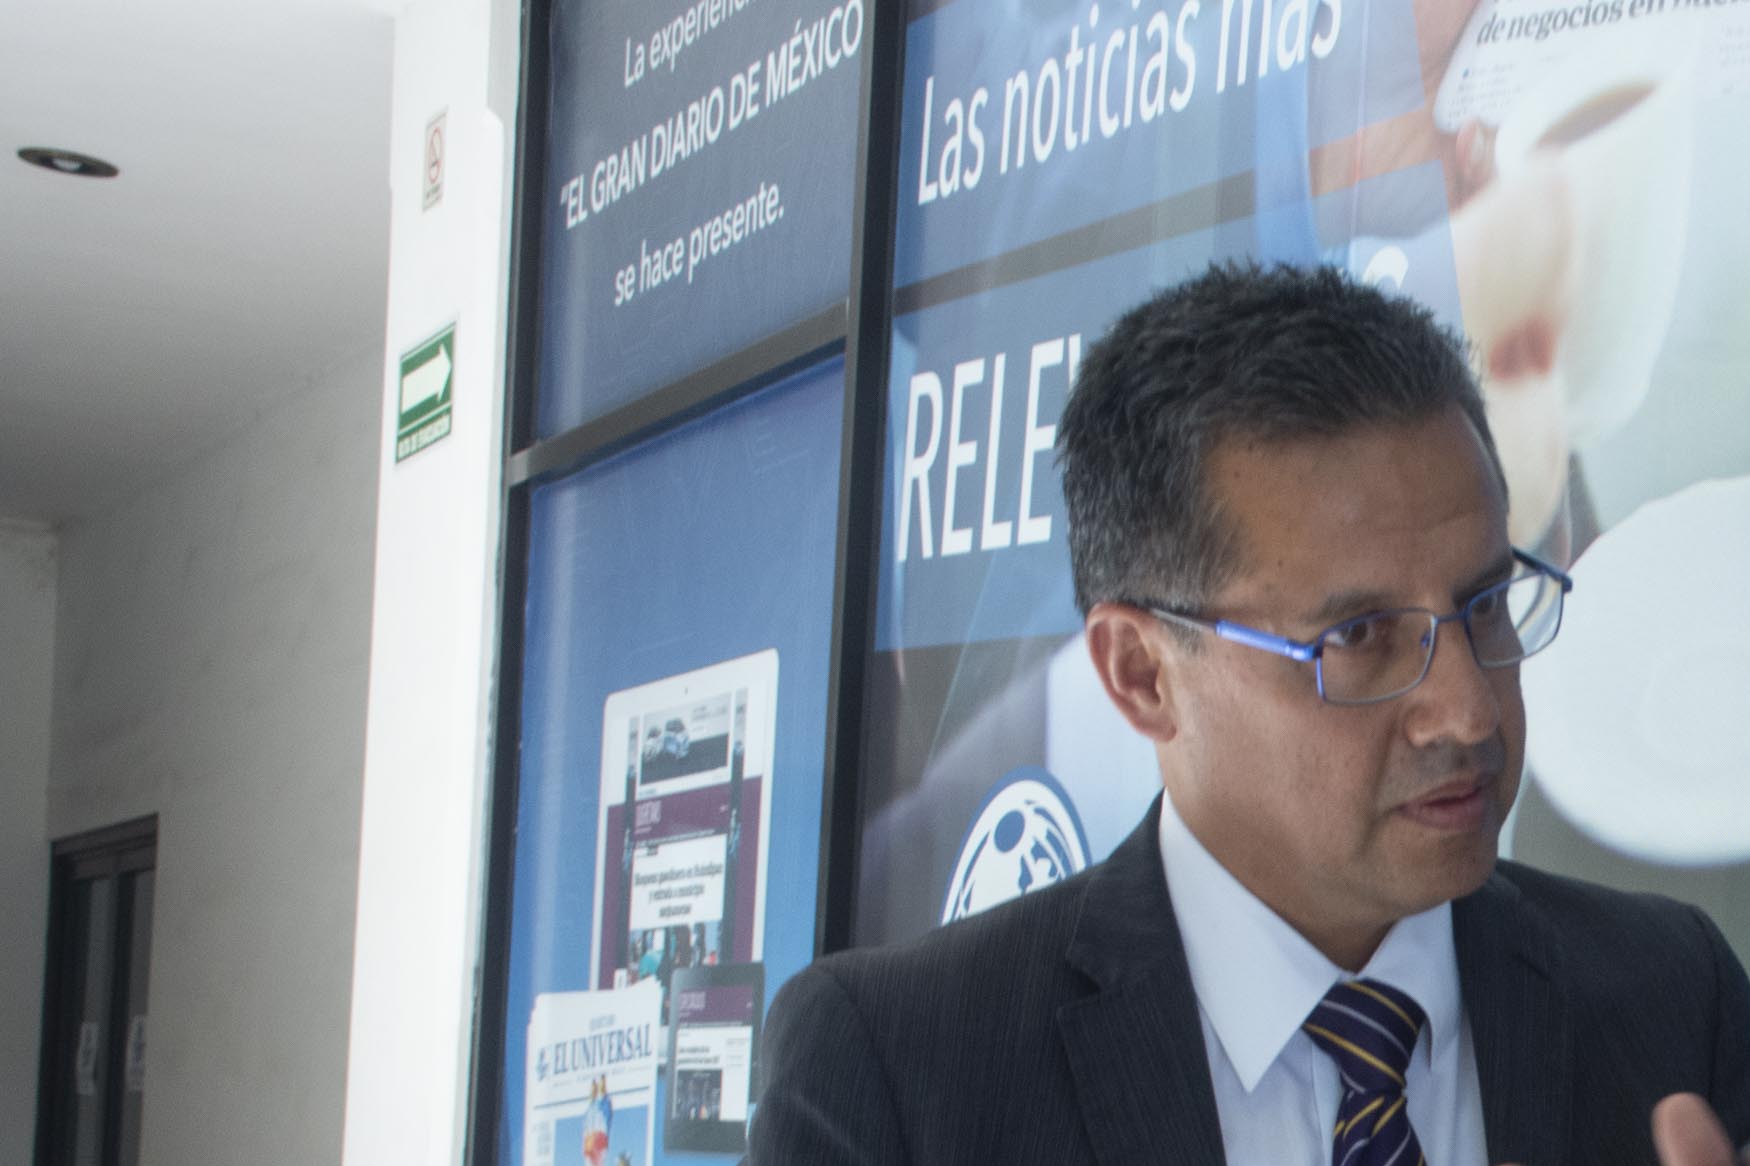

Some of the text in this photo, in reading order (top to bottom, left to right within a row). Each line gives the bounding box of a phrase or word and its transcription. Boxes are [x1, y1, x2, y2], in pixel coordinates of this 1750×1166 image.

[624, 36, 645, 88] La
[1476, 11, 1506, 46] de
[1507, 1, 1623, 42] negocios
[590, 134, 648, 215] GRAN
[650, 85, 725, 180] DIARIO
[729, 60, 761, 131] DE
[766, 0, 864, 108] MÉXICO
[918, 76, 988, 206] Las
[1000, 0, 1199, 175] noticias
[614, 181, 785, 307] se hace presente.
[570, 1022, 653, 1072] UNIVERSAL
